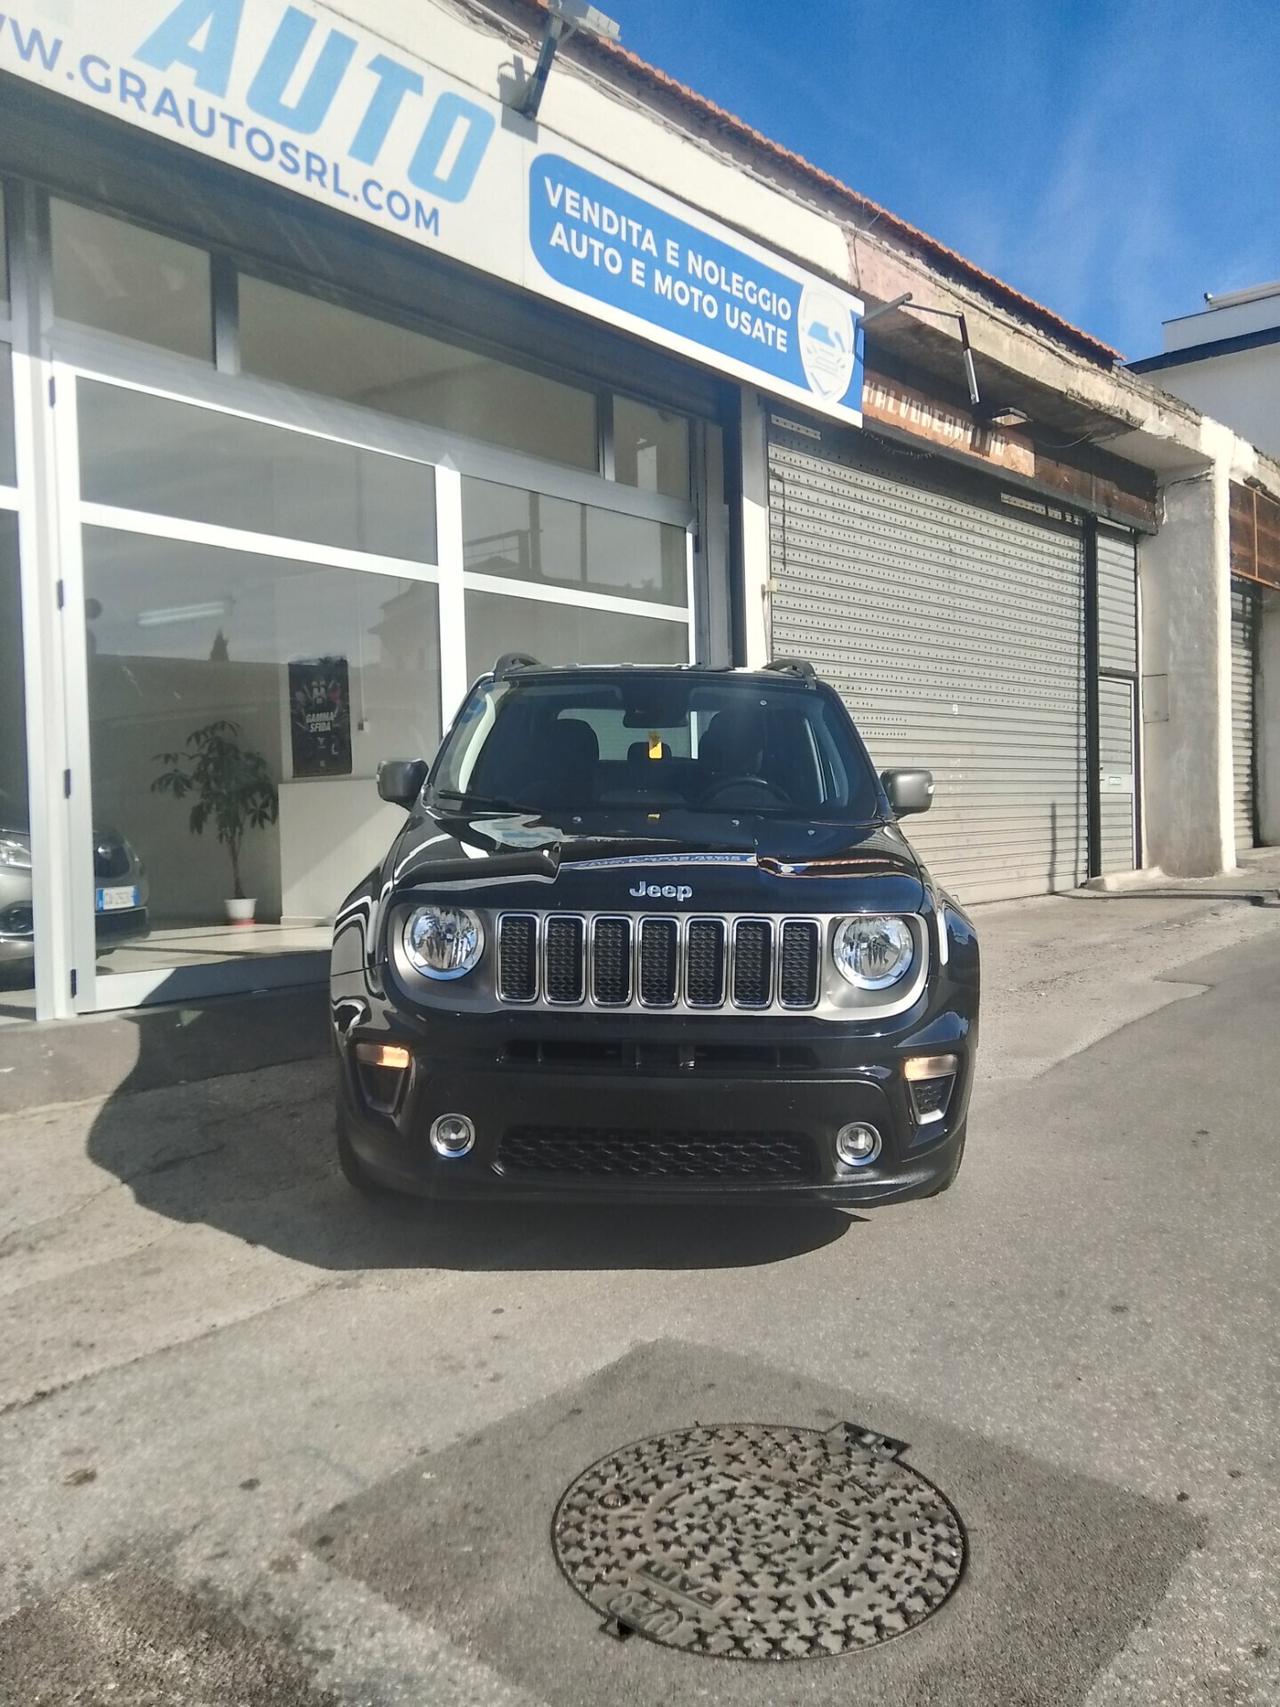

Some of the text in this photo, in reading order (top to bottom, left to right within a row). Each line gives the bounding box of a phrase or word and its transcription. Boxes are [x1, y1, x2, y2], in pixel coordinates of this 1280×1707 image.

[0, 13, 440, 236] W.GRAUTOSRL.COM
[133, 0, 495, 204] AUTO
[544, 176, 792, 321] VENDITA E NOLEGGIO
[549, 222, 788, 353] AUTO E MOTO USATE
[310, 722, 331, 733] SFIDA
[629, 880, 693, 902] Jeep
